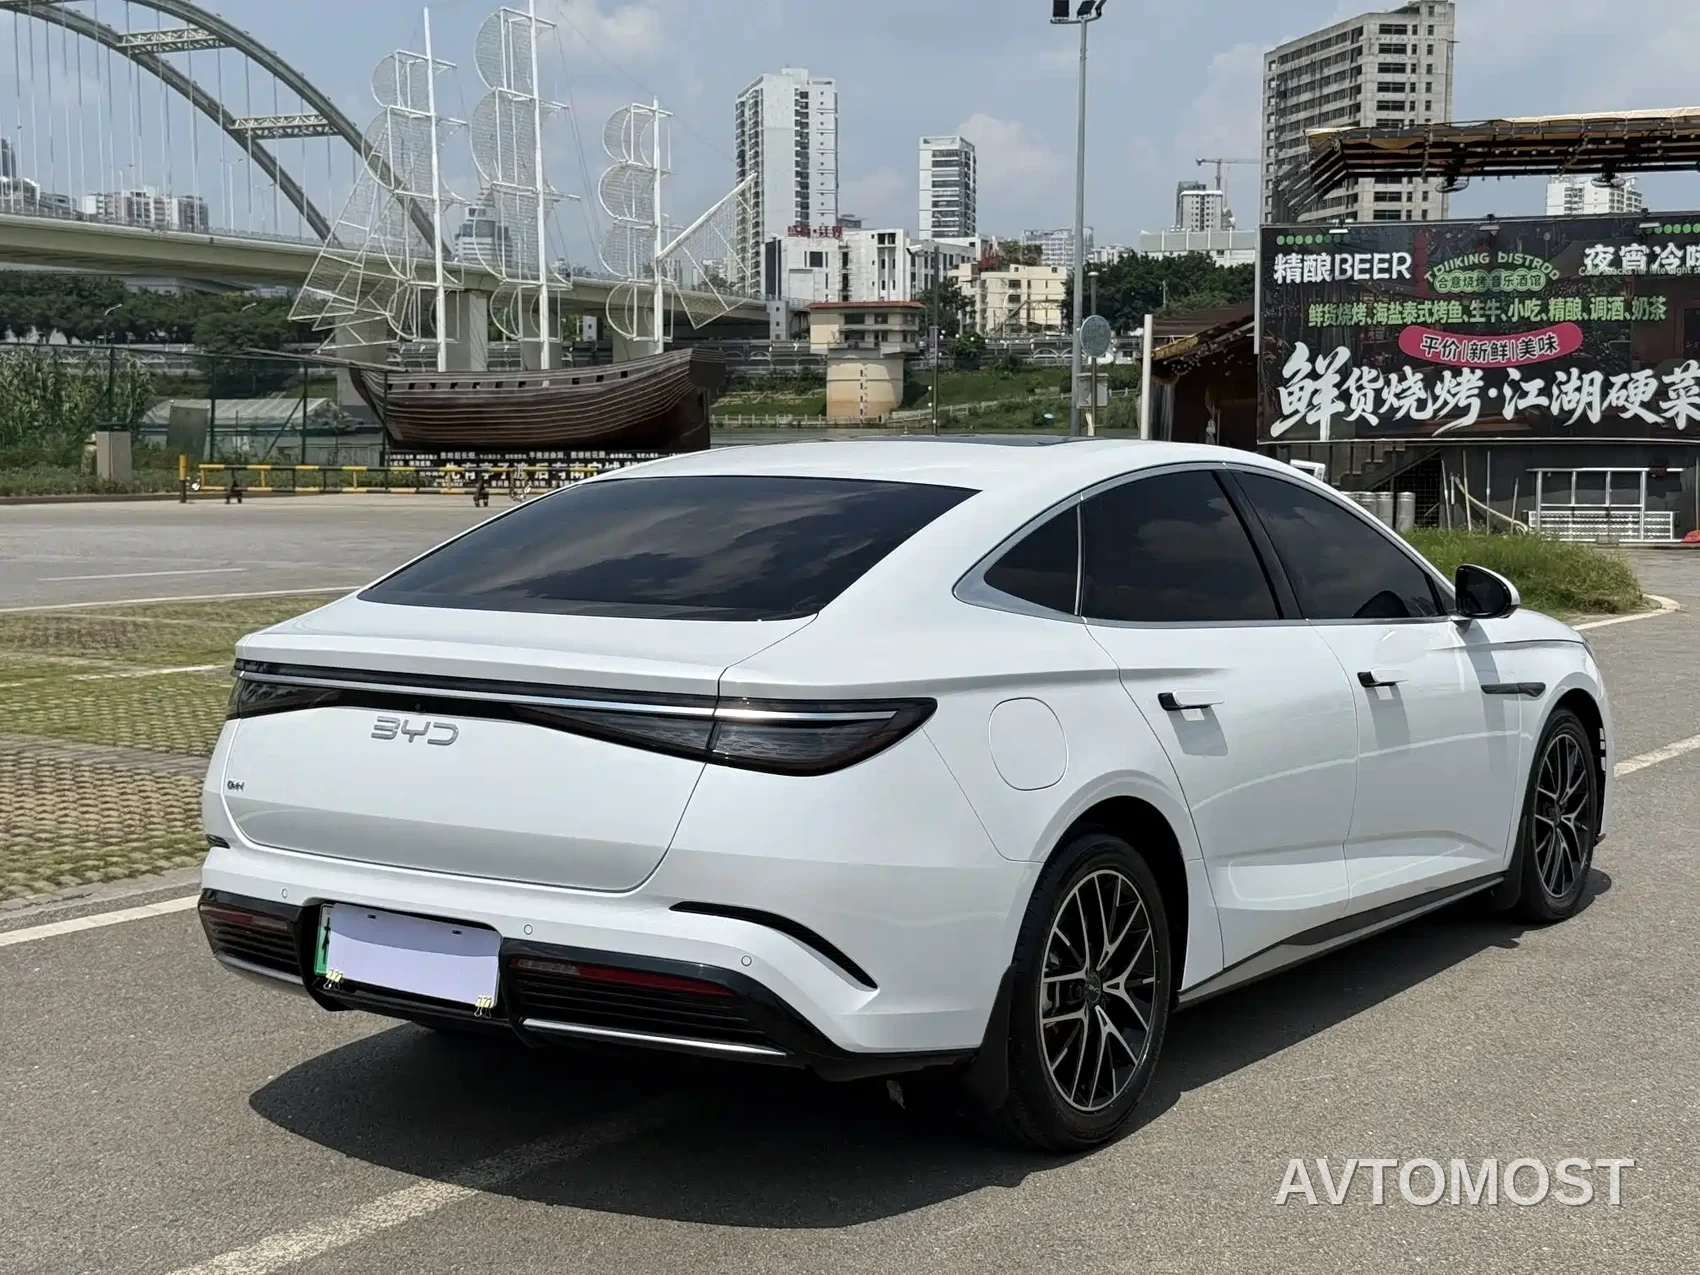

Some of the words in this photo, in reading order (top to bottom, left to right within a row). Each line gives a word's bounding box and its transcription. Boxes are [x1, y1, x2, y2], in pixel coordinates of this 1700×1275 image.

[1270, 341, 1700, 442] 鲜货烧烤·江湖硬菜
[371, 716, 459, 746] BYD
